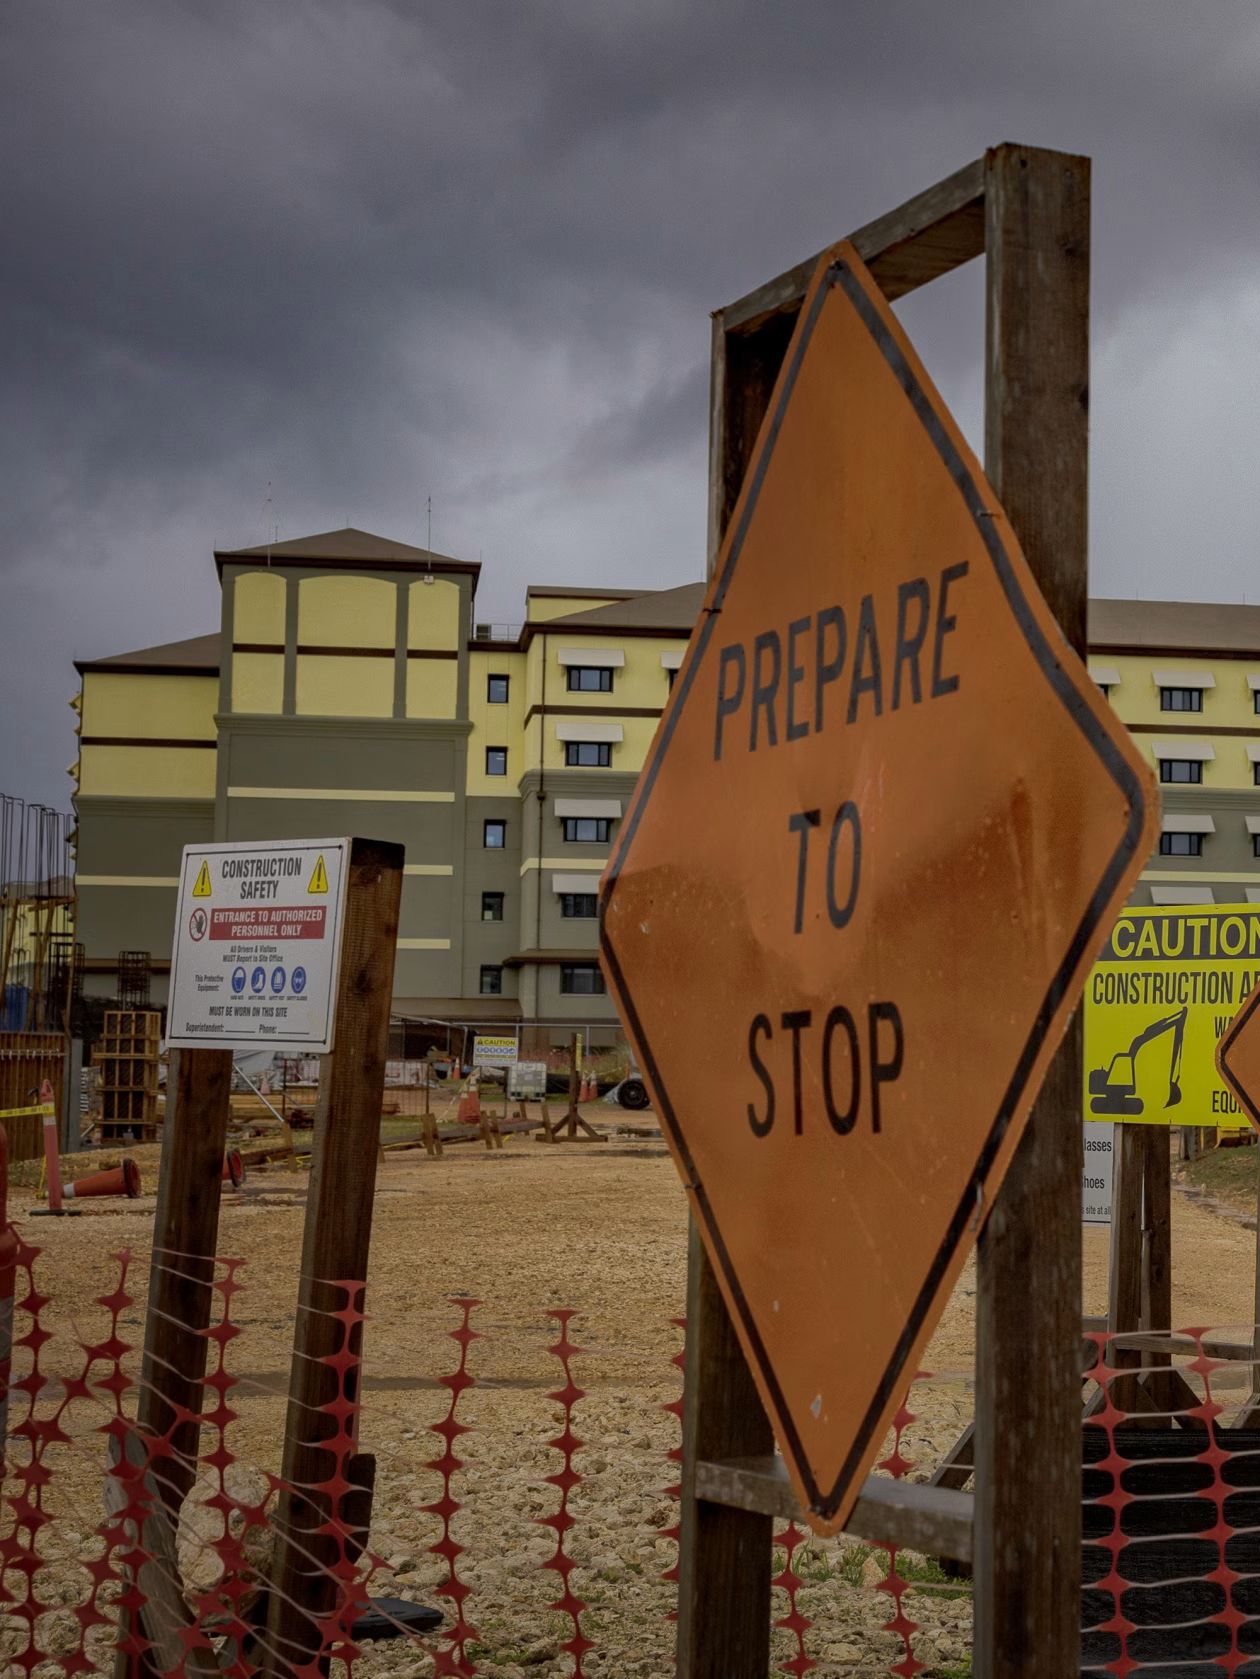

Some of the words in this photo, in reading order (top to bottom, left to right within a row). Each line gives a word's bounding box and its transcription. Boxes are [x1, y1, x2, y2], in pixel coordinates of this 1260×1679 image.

[712, 560, 970, 762] PREPARE
[222, 857, 302, 878] CONSTRUCTION
[788, 801, 862, 936] TO
[240, 880, 279, 899] SAFETY
[214, 911, 256, 922] ENTRANCE
[258, 910, 269, 922] TO
[271, 909, 323, 921] AUTHORIZED
[231, 925, 278, 937] PERSONNEL
[281, 924, 302, 936] ONLY
[238, 945, 253, 953] Drivers
[237, 955, 253, 964] Report
[269, 954, 283, 962] Office
[1093, 971, 1234, 1005] CONSTRUCTION
[209, 1006, 224, 1016] MUST
[225, 1007, 233, 1016] BE
[234, 1007, 251, 1017] WORN
[252, 1007, 260, 1017] ON
[262, 1007, 274, 1017] THIS
[275, 1007, 288, 1018] SITE
[259, 1024, 277, 1034] Phone:
[747, 1001, 905, 1138] STOP
[1084, 1138, 1112, 1152] lasses
[1083, 1176, 1105, 1189] hoes
